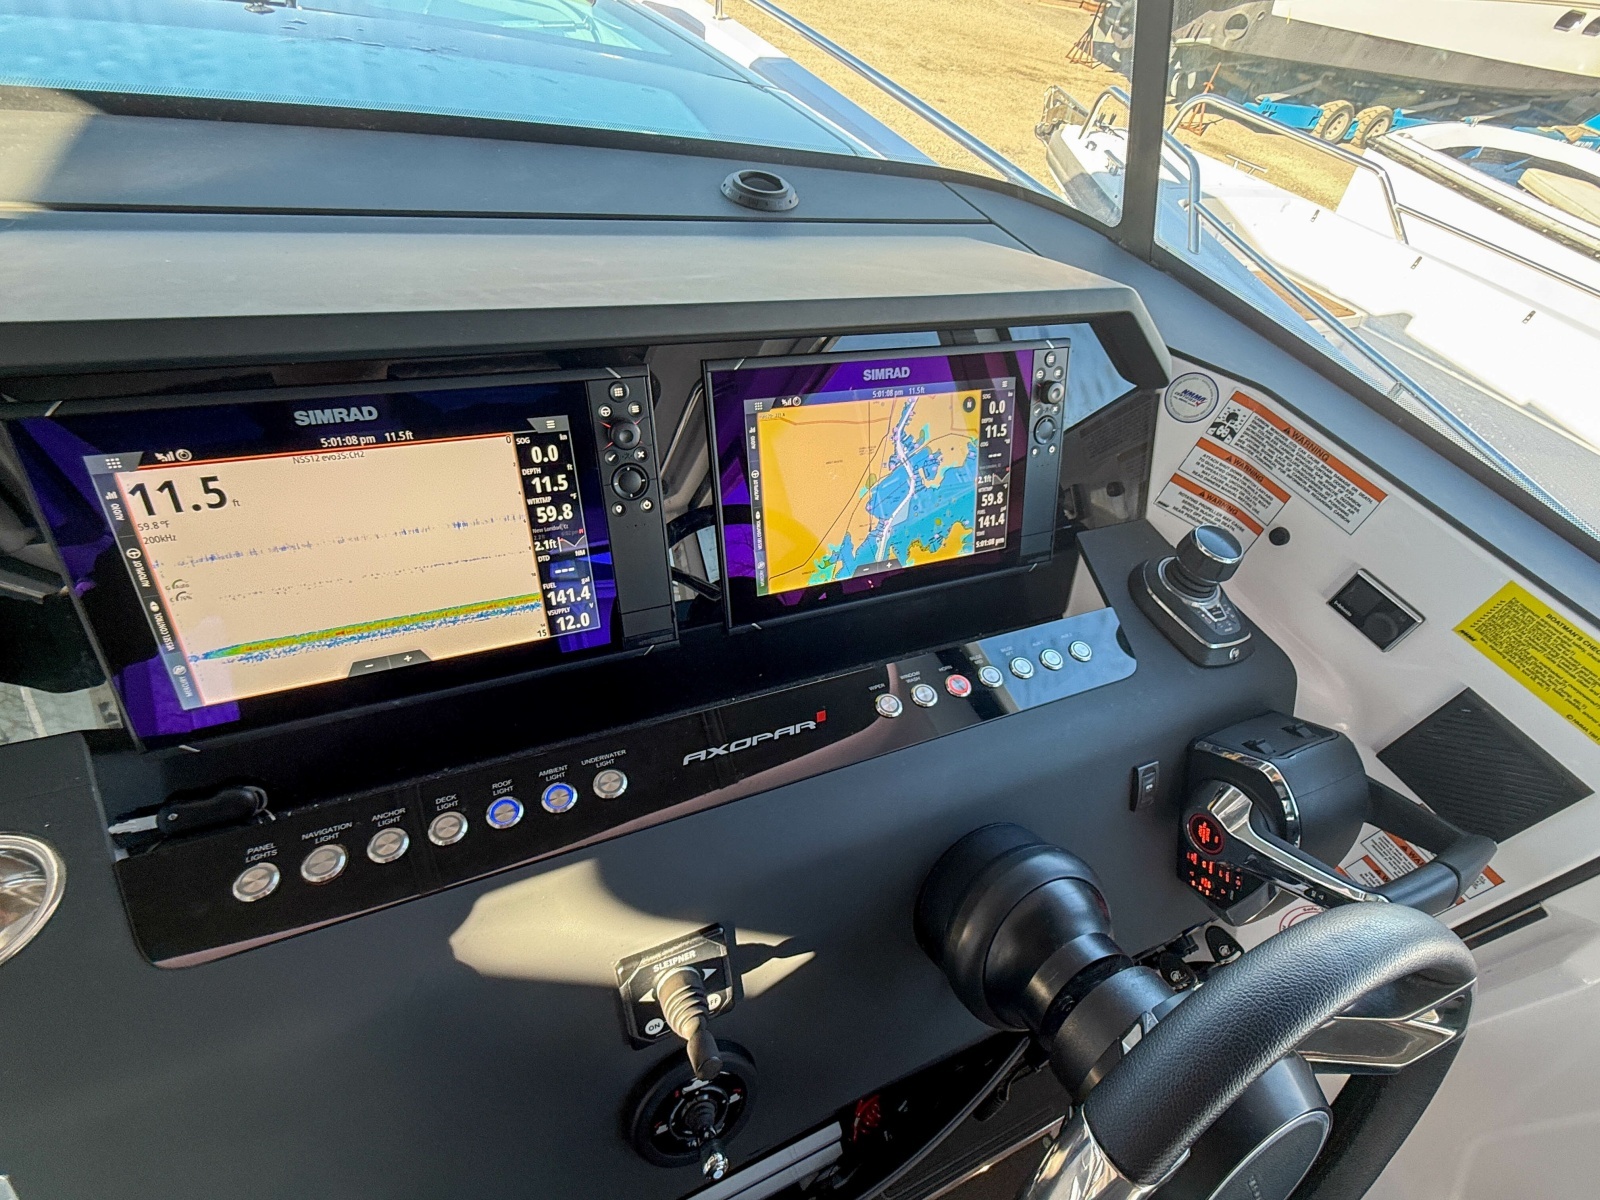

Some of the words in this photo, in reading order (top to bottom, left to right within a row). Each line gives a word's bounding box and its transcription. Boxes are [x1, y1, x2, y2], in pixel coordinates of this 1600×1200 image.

[863, 366, 910, 381] SIMRAD
[989, 400, 1006, 414] 0.0
[294, 406, 378, 426] SIMRAD
[985, 424, 1007, 438] 11.5
[320, 435, 358, 448] 5:01:08
[360, 435, 376, 447] pm
[516, 436, 530, 445] SOG
[1290, 431, 1331, 461] WARNING
[531, 444, 558, 464] 0.0
[522, 467, 542, 476] DEPTH
[1231, 458, 1264, 482] WARNING
[531, 474, 568, 494] 11.5
[128, 476, 227, 516] 11.5
[232, 499, 240, 508] ft
[981, 492, 1004, 506] 59.8
[1205, 493, 1238, 516] WARNING
[536, 503, 573, 524] 59.8
[978, 513, 1005, 528] 141.4
[144, 534, 177, 544] 200kHz
[542, 582, 556, 590] FUEL
[547, 586, 590, 606] 141.4
[547, 606, 571, 616] VSUPPLY
[556, 612, 590, 631] 12.0
[1545, 613, 1583, 641] BOATMAN'S
[537, 629, 547, 638] 15
[682, 720, 817, 766] AXOPAR
[581, 749, 626, 766] UNDERWATER
[595, 758, 615, 768] LIGHT
[538, 764, 568, 778] AMBIENT
[546, 772, 566, 782] LIGHT
[492, 779, 513, 790] ROOF
[492, 785, 514, 796] LIGHT
[435, 794, 457, 804] DECK
[436, 800, 458, 812] LIGHT
[371, 807, 406, 822] ANCHOR
[377, 816, 401, 828] LIGHT
[301, 822, 352, 840] NAVIGATION
[314, 832, 340, 844] LIGHT
[246, 842, 277, 854] PANEL
[245, 850, 278, 864] LIGHTS
[652, 950, 696, 973] SLEIPNER
[648, 1022, 661, 1032] ON
